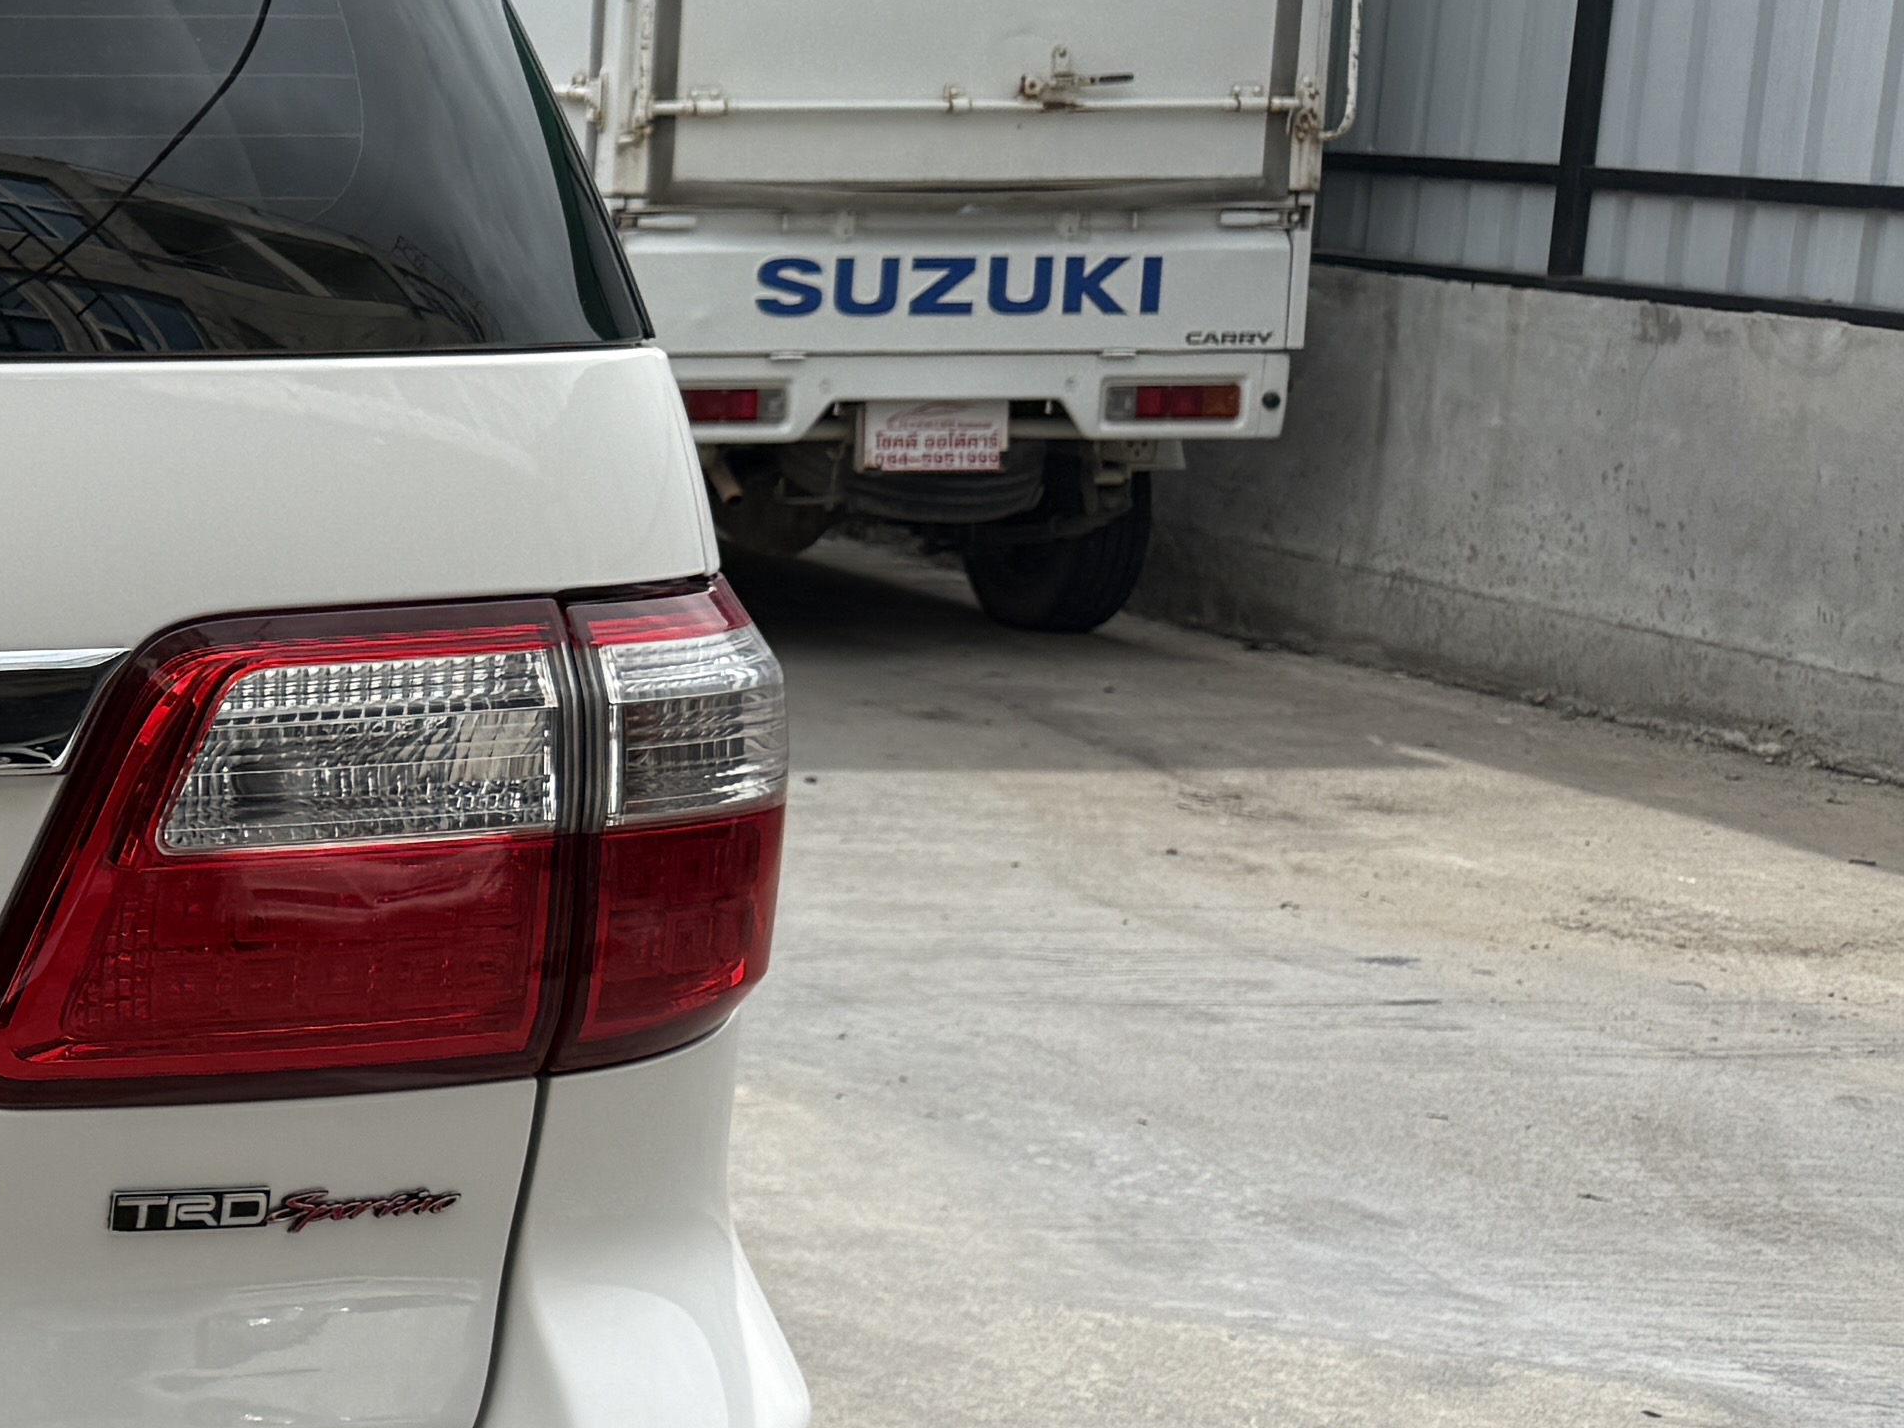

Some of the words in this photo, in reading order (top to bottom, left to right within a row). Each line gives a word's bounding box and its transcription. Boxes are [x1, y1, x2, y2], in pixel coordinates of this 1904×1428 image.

[755, 256, 1163, 318] SUZUKI
[1185, 331, 1274, 345] CARRY
[115, 1192, 269, 1230] TRD
